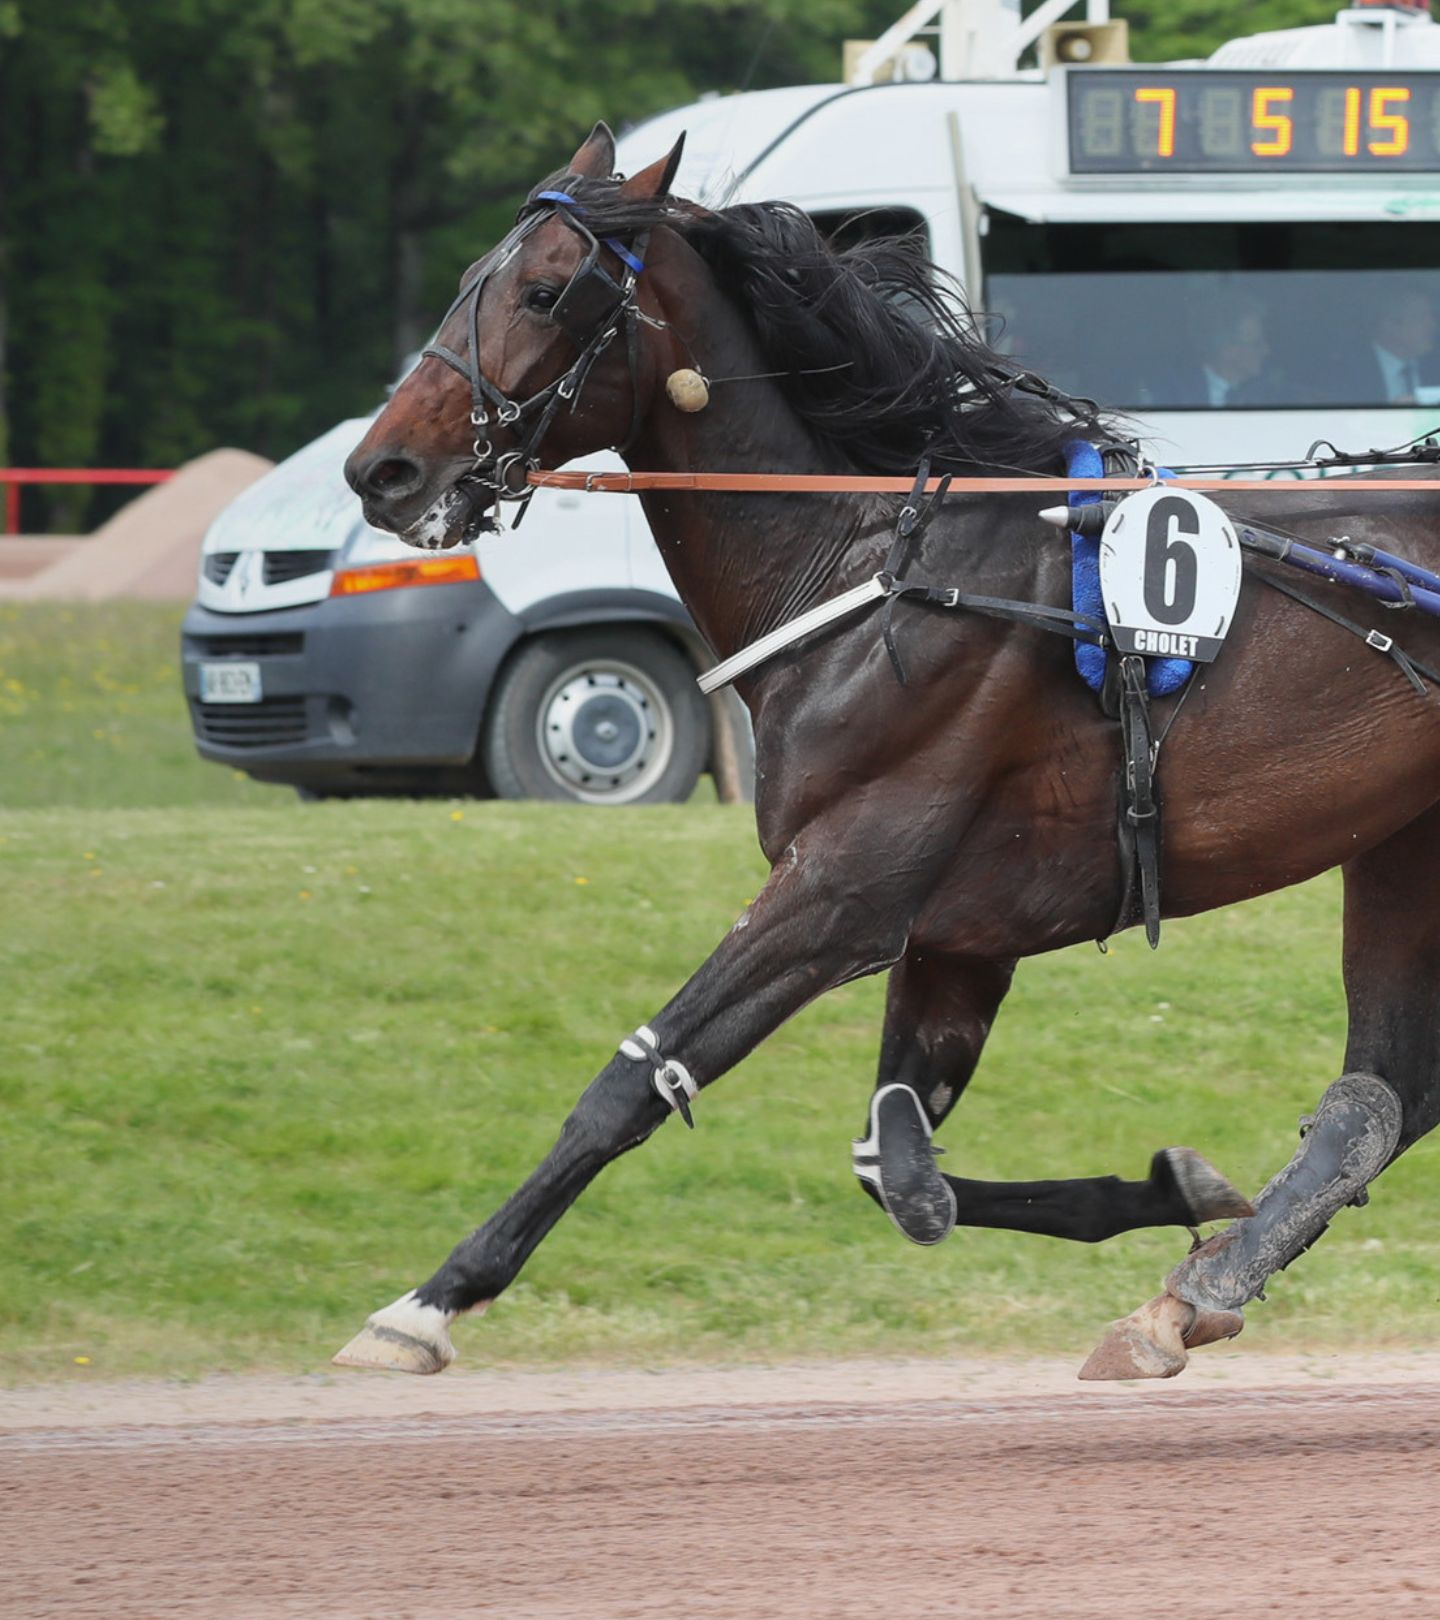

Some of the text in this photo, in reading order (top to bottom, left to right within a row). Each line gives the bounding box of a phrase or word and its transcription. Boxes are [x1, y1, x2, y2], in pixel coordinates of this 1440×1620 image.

[1135, 87, 1411, 157] 7 5 15
[1143, 496, 1200, 625] 6
[1134, 630, 1199, 657] CHOLET
